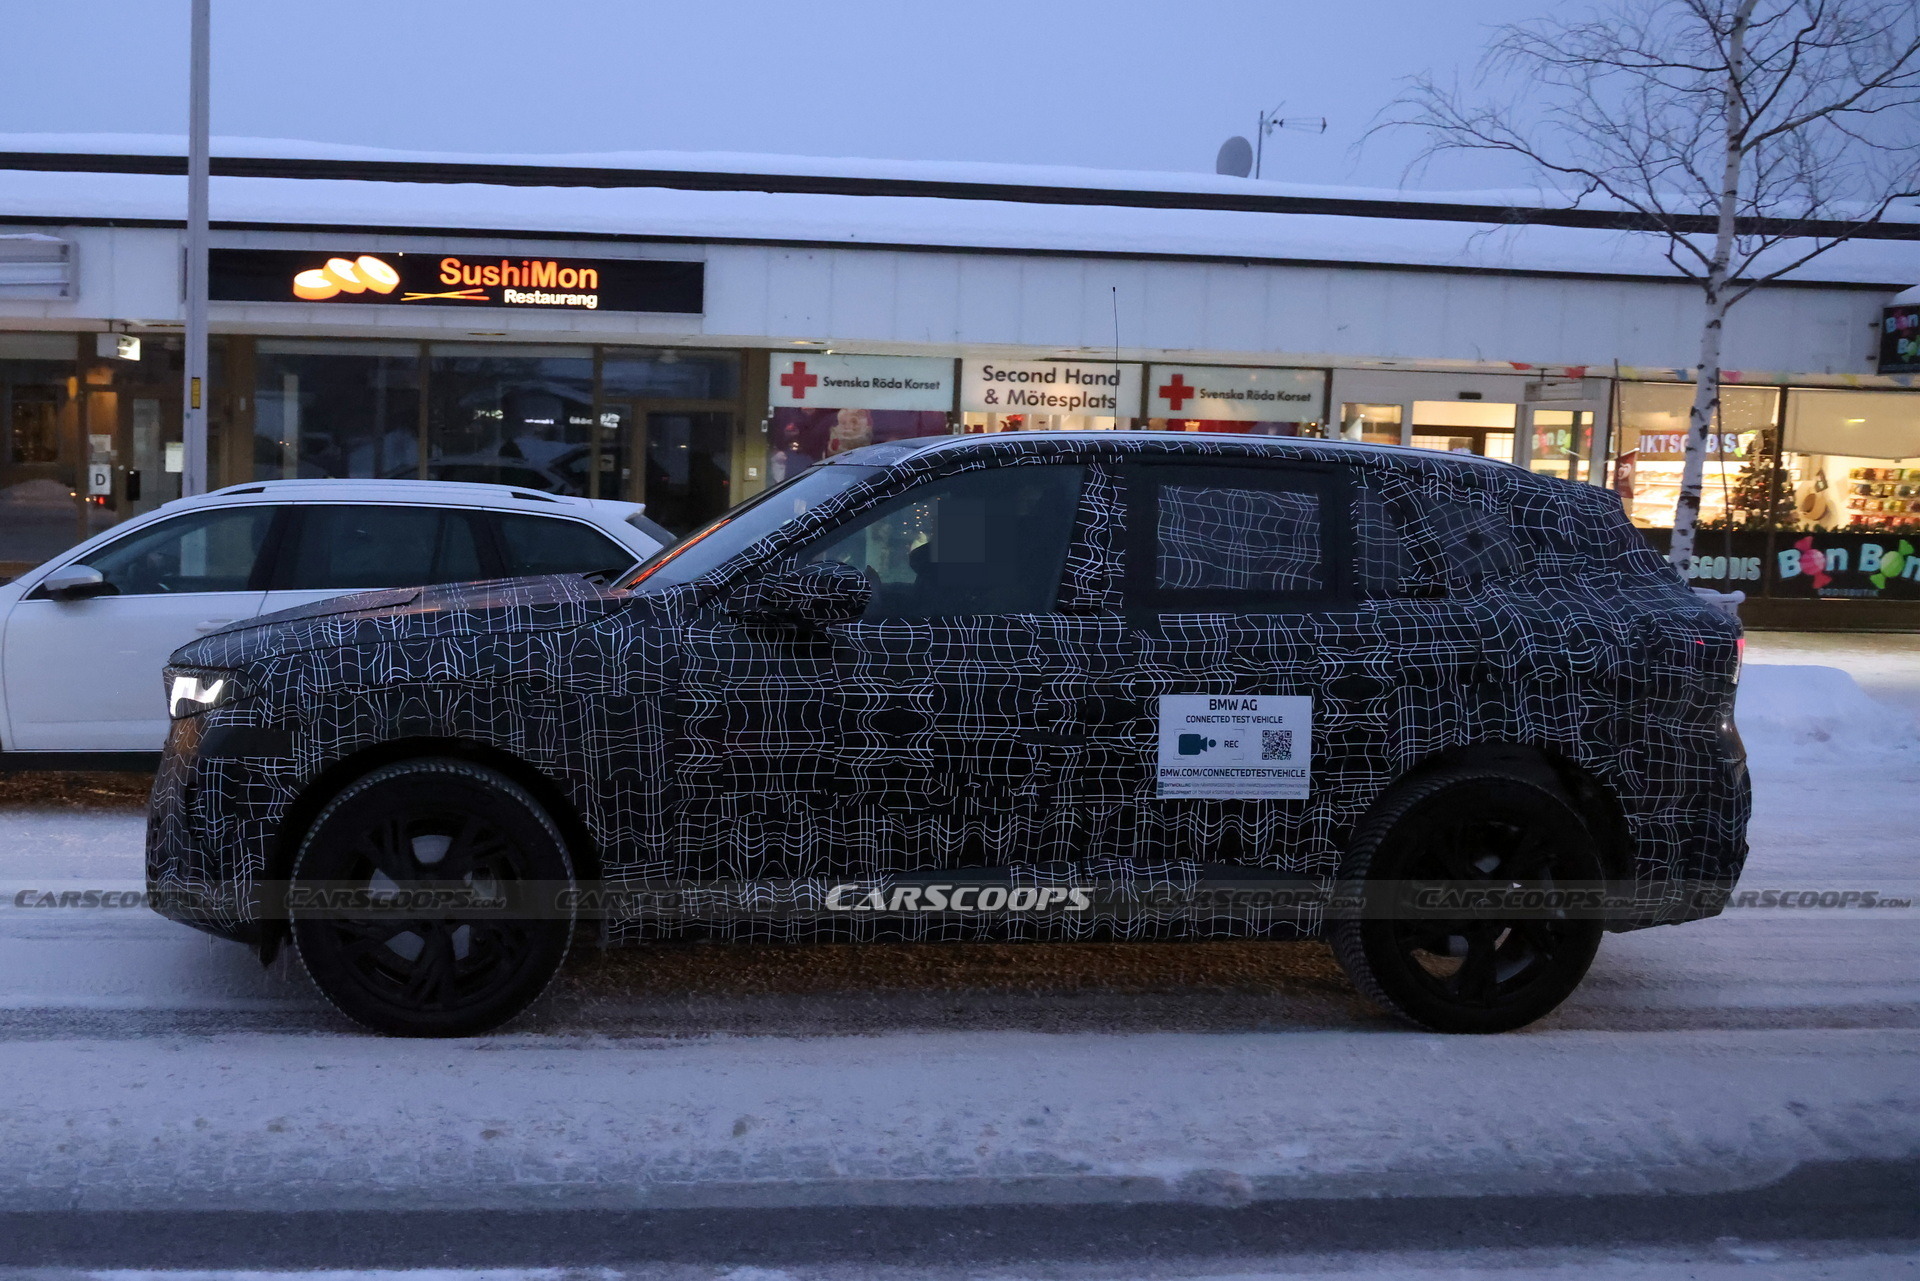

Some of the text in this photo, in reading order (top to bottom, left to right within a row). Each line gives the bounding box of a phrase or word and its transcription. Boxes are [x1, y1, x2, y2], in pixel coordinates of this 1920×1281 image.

[440, 257, 598, 290] SushiMon
[504, 289, 598, 309] Restaurang
[1896, 338, 1920, 357] Bo
[982, 365, 1121, 386] Second Hand
[823, 376, 941, 390] Svenska Röda Korset
[984, 388, 1117, 411] & Mötesplats
[1200, 388, 1312, 402] Svenska Röda Korset
[95, 473, 106, 486] D
[1687, 555, 1762, 581] SGODIS
[1209, 698, 1258, 711] BMW AG
[1185, 715, 1283, 724] CONNECTED TEST VEHICLE
[1224, 740, 1239, 748] REC
[1160, 768, 1306, 778] BMW.COM/CONNECTEDTESTVEHICLE
